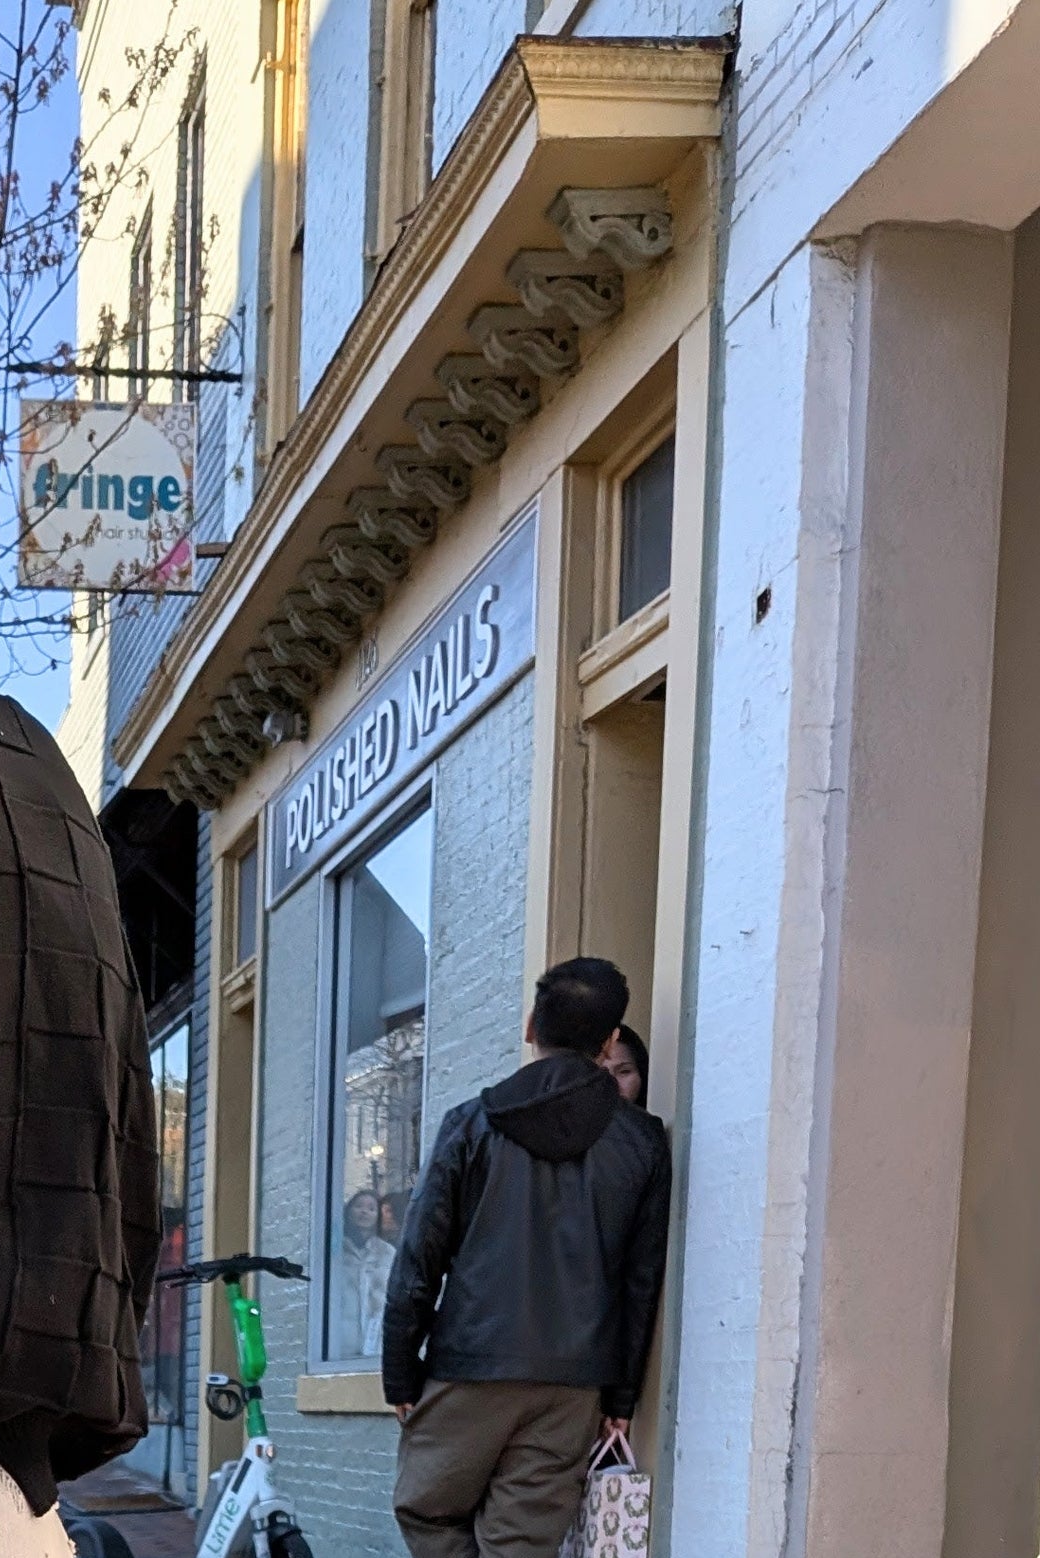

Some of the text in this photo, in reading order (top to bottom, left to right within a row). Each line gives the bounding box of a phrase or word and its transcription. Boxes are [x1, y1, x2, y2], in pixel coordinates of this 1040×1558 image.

[33, 463, 181, 520] fringe
[127, 525, 175, 541] stuio
[285, 584, 498, 869] POLISHED NAILS
[206, 1498, 242, 1554] Lime
